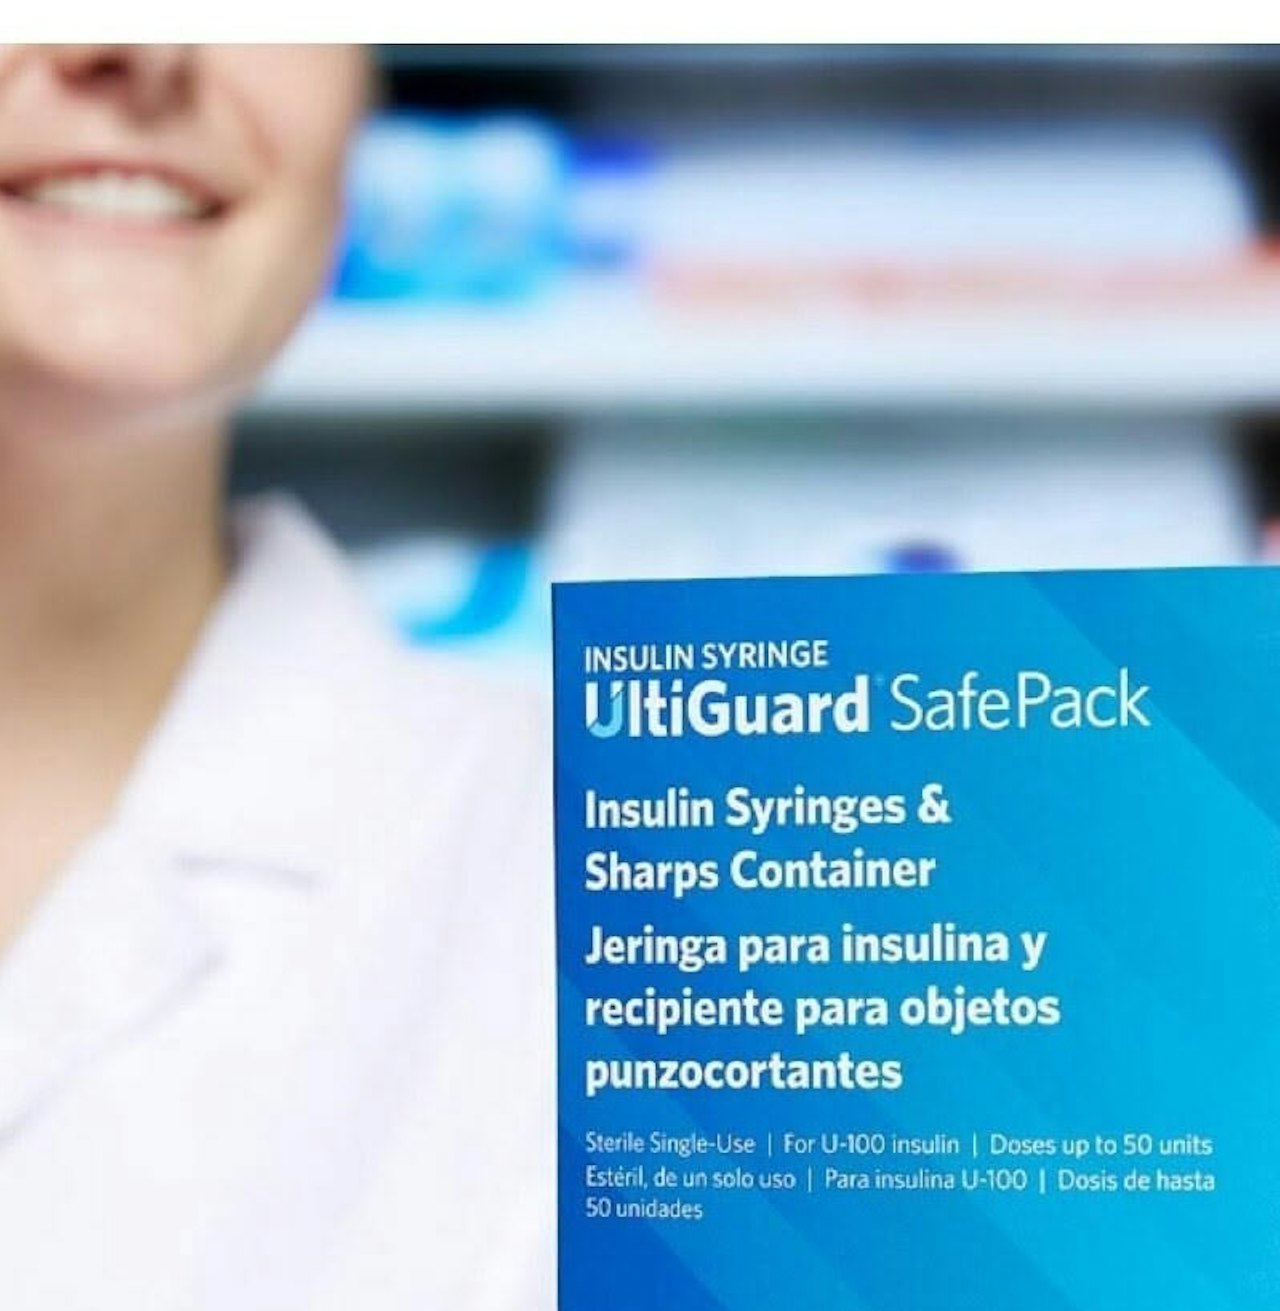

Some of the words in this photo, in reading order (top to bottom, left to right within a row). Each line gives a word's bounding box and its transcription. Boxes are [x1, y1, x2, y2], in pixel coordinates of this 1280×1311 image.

[585, 644, 694, 673] INSULIN
[701, 639, 828, 670] SYRINGE
[585, 674, 870, 737] UltiGuard
[890, 667, 1150, 732] SafePack
[585, 787, 714, 829] Insulin
[725, 785, 907, 835] Syringes
[917, 783, 952, 824] &
[585, 851, 720, 898] Sharps
[730, 847, 937, 889] Container
[585, 924, 727, 973] Jeringa
[739, 933, 830, 973] para
[842, 922, 1010, 963] insulina
[1020, 932, 1047, 971] y
[585, 986, 784, 1035] recipiente
[796, 997, 889, 1035] para
[899, 985, 1061, 1035] objetos
[586, 1052, 903, 1097] punzocortantes
[585, 1131, 645, 1153] Sterile
[649, 1131, 757, 1158] Single-Use
[783, 1132, 816, 1154] For
[821, 1133, 886, 1155] U-100
[892, 1134, 960, 1155] insulin
[990, 1133, 1057, 1156] Doses
[1061, 1139, 1090, 1159] up
[1094, 1135, 1118, 1156] to
[1123, 1133, 1153, 1156] 50
[1159, 1134, 1213, 1156] units
[585, 1164, 648, 1189] Estéril,
[653, 1166, 678, 1188] de
[682, 1171, 708, 1188] un
[712, 1167, 754, 1189] solo
[758, 1172, 797, 1189] uso
[825, 1167, 870, 1189] Para
[874, 1168, 956, 1190] insulina
[961, 1168, 1028, 1191] U-100
[1058, 1168, 1118, 1192] Dosis
[1123, 1169, 1151, 1191] de
[1156, 1169, 1216, 1192] hasta
[586, 1196, 612, 1218] 50
[616, 1198, 703, 1220] unidades
